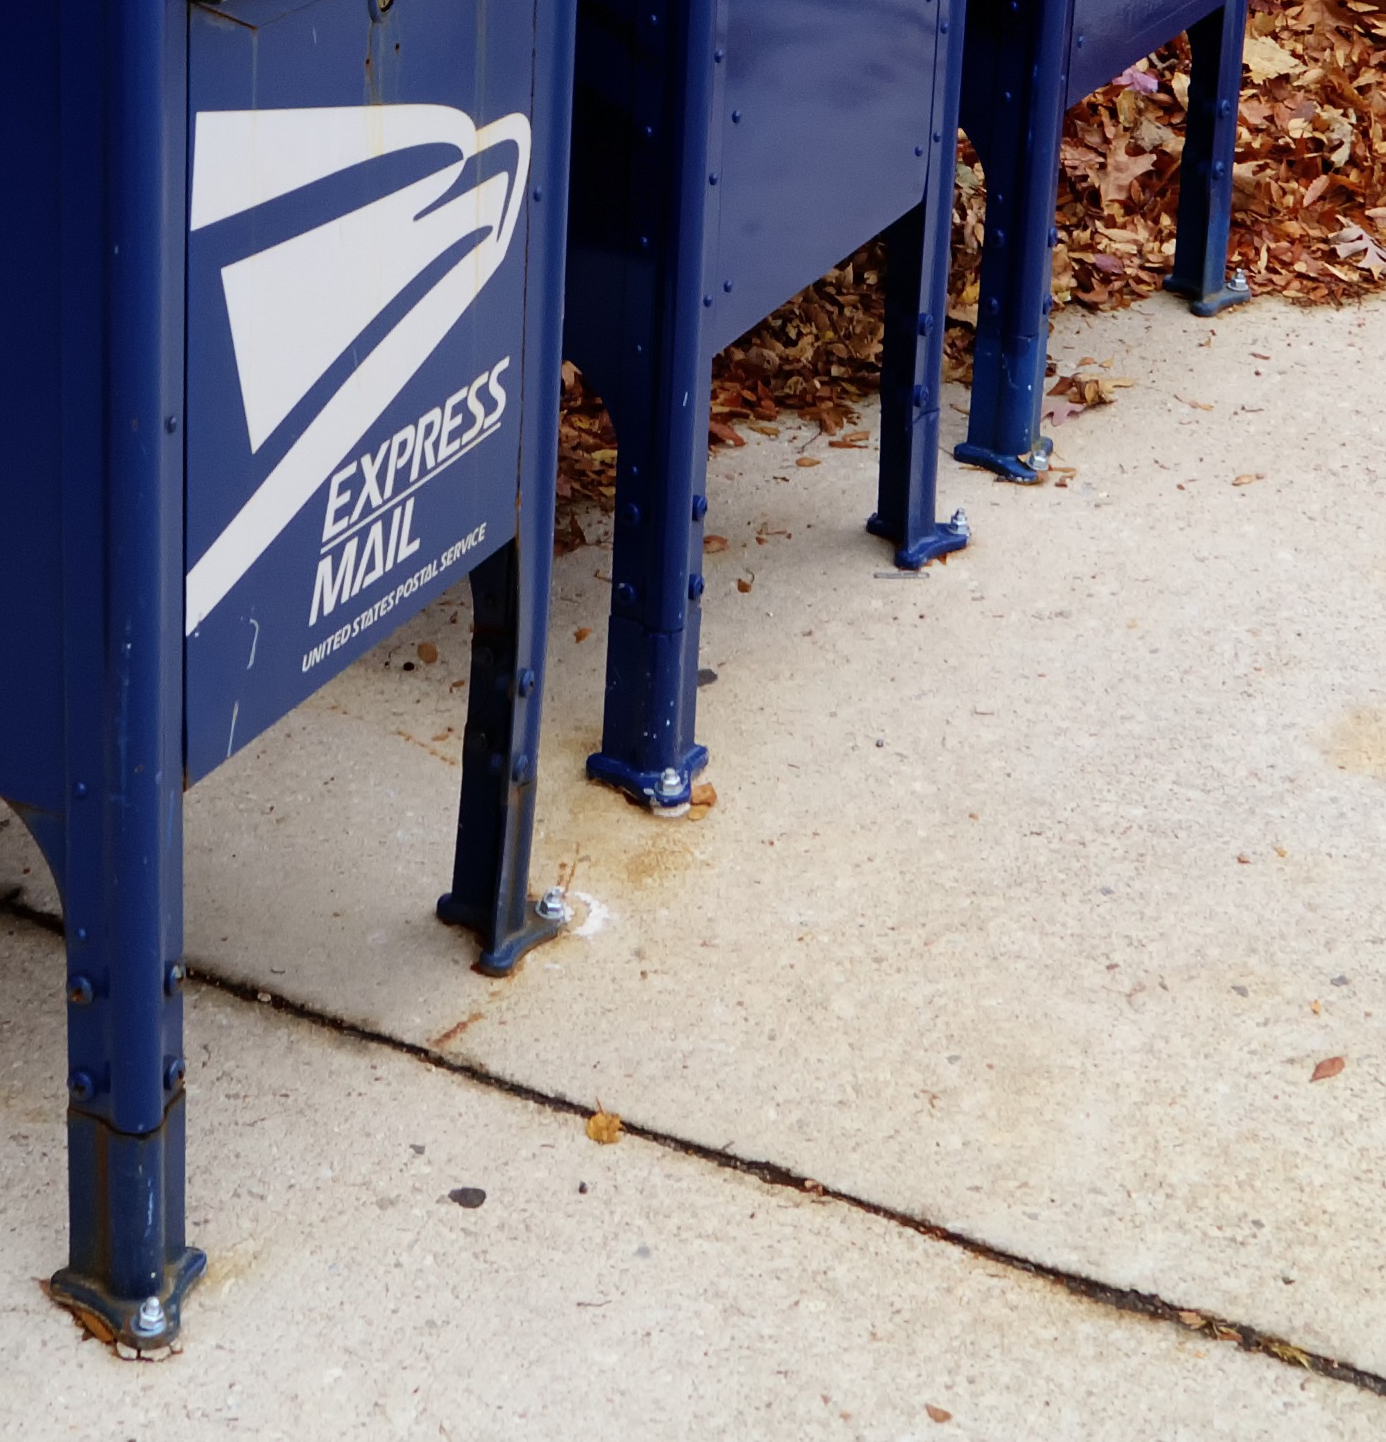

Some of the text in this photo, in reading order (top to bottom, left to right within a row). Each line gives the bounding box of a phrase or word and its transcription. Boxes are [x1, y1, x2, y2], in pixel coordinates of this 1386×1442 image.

[322, 356, 510, 543] EXPRESS
[302, 522, 487, 673] UNITED STATES POSTAL SERVICE
[309, 496, 421, 627] MAIL
